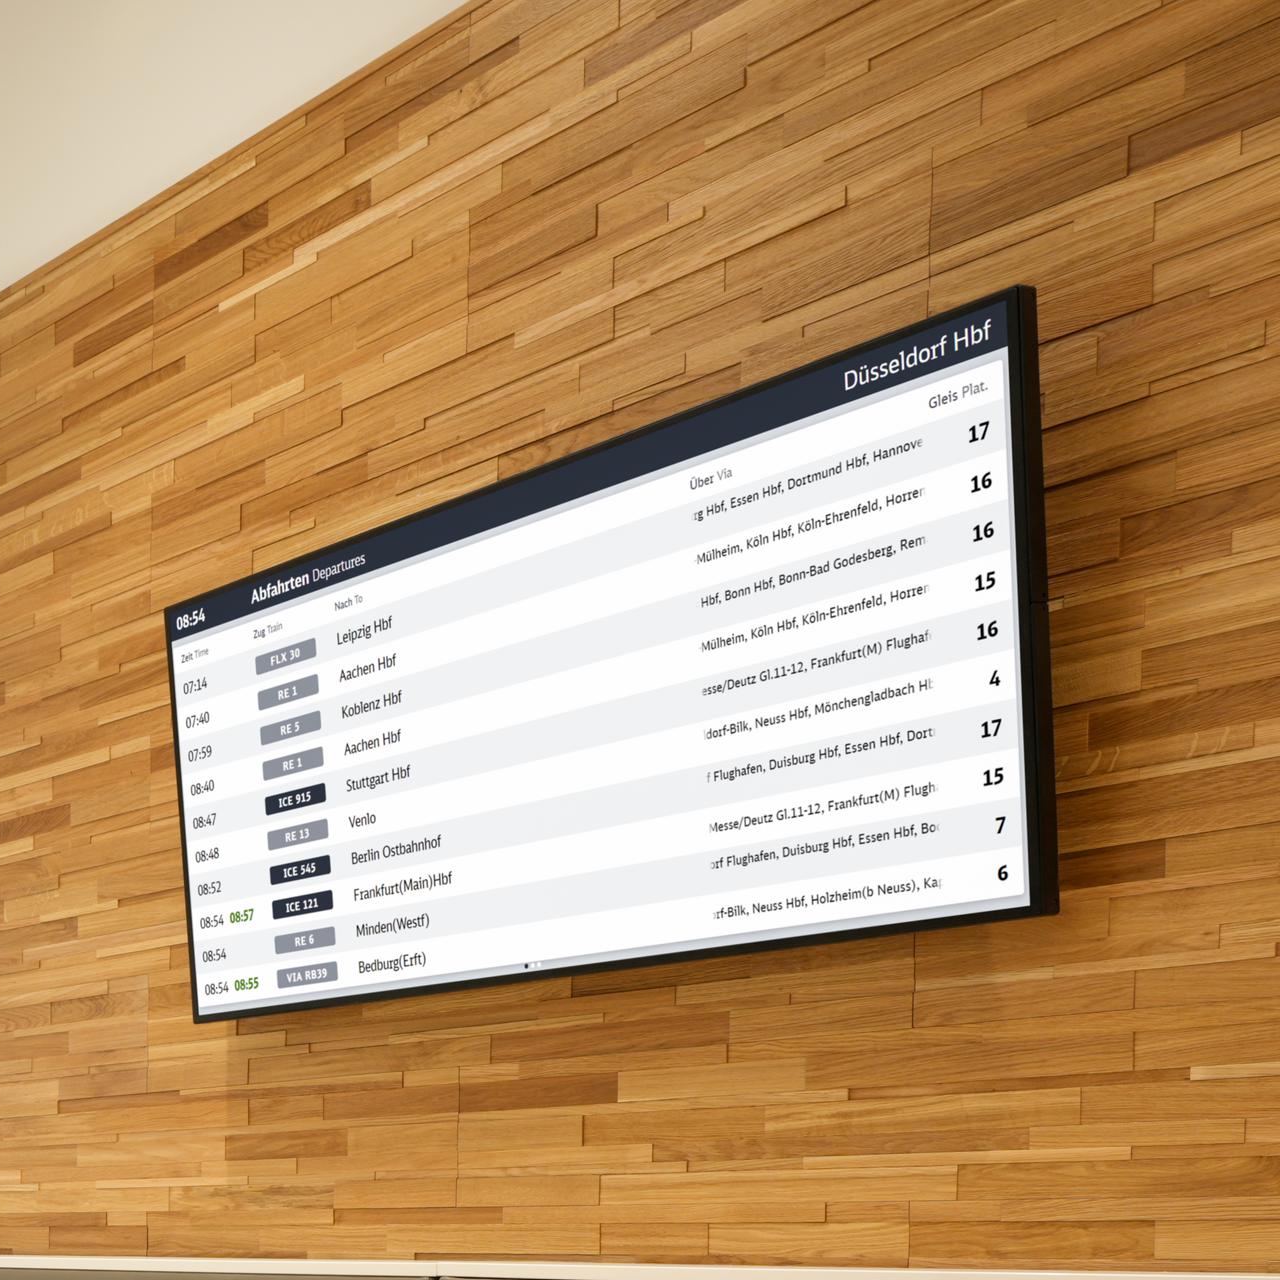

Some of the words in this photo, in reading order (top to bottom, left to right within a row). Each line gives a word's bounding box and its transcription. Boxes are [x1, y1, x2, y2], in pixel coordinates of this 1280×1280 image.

[844, 335, 946, 391] Düsseldorf
[953, 319, 992, 351] Hbf
[928, 390, 957, 409] Gleis
[961, 384, 988, 399] Plat.
[968, 421, 990, 443] 17
[690, 472, 714, 490] Über
[716, 468, 732, 481] Via
[692, 508, 704, 522] rg
[706, 499, 728, 517] Hbf,
[730, 492, 759, 510] Essen
[762, 483, 784, 499] Hbf,
[787, 462, 842, 491] Dortmund
[846, 455, 869, 472] Hbf,
[970, 472, 993, 493] 16
[746, 534, 769, 550] Köln
[772, 526, 795, 542] Hbf,
[798, 501, 882, 534] Köln-Ehrenfeld,
[972, 522, 994, 542] 16
[251, 572, 309, 603] Abfahrten
[313, 555, 365, 581] Departures
[701, 590, 722, 608] Hbf,
[725, 584, 751, 601] Bonn
[754, 577, 776, 593] Hbf,
[779, 561, 830, 586] Bonn-Bad
[833, 542, 896, 570] Godesberg,
[974, 572, 996, 592] 15
[335, 599, 352, 611] Nach
[355, 595, 363, 604] To
[176, 609, 206, 630] 08:54
[751, 624, 774, 639] Köln
[777, 617, 799, 633] Hbf,
[802, 594, 886, 626] Köln-Ehrenfeld,
[253, 629, 265, 639] Zug
[267, 622, 283, 634] Train
[337, 625, 371, 645] Leipzig
[374, 616, 393, 634] Hbf
[976, 621, 999, 641] 16
[181, 652, 193, 663] Zeit
[195, 648, 208, 658] Time
[270, 651, 287, 666] FLX
[289, 648, 300, 659] 30
[760, 662, 807, 682] Gl.11-12,
[811, 642, 882, 669] Frankfurt(M)
[885, 628, 932, 652] Flughaf
[339, 663, 375, 682] Aachen
[378, 654, 397, 671] Hbf
[989, 670, 1001, 686] 4
[183, 677, 207, 694] 07:14
[278, 688, 290, 700] RE
[292, 687, 297, 696] 1
[342, 700, 381, 719] Koblenz
[383, 691, 402, 708] Hbf
[755, 713, 786, 728] Neuss
[789, 705, 811, 721] Hbf,
[815, 682, 914, 714] Mönchengladbach
[186, 712, 210, 728] 07:40
[281, 725, 292, 735] RE
[295, 722, 300, 732] 5
[980, 719, 1003, 739] 17
[344, 737, 380, 755] Aachen
[382, 729, 401, 746] Hbf
[188, 746, 212, 761] 07:59
[714, 763, 766, 782] Flughafen,
[769, 752, 815, 771] Duisburg
[819, 744, 841, 760] Hbf,
[845, 740, 876, 755] Essen
[879, 732, 903, 747] Hbf,
[907, 727, 935, 741] Dort
[283, 760, 295, 770] RE
[297, 758, 302, 767] 1
[191, 779, 215, 796] 08:40
[346, 771, 390, 792] Stuttgart
[392, 765, 411, 782] Hbf
[982, 768, 1004, 787] 15
[279, 796, 293, 809] ICE
[295, 791, 311, 804] 915
[776, 803, 824, 821] Gl.11-12,
[828, 786, 900, 812] Frankfurt(M)
[904, 782, 938, 797] Flugh
[193, 813, 217, 829] 08:47
[349, 812, 376, 829] Venlo
[995, 817, 1006, 834] 7
[285, 830, 297, 842] RE
[300, 827, 310, 839] 13
[726, 847, 779, 867] Flughafen,
[782, 839, 829, 858] Duisburg
[833, 835, 855, 848] Hbf,
[858, 830, 889, 844] Essen
[893, 822, 917, 838] Hbf,
[195, 847, 219, 863] 08:48
[351, 846, 379, 865] Berlin
[383, 835, 442, 858] Ostbahnhof
[283, 866, 297, 879] ICE
[301, 862, 316, 874] 545
[998, 865, 1008, 881] 6
[197, 880, 222, 896] 08:52
[353, 871, 452, 902] Frankfurt(Main)Hbf
[286, 900, 300, 912] ICE
[303, 898, 318, 909] 121
[752, 899, 782, 914] Neuss
[786, 894, 808, 908] Hbf,
[811, 885, 873, 906] Holzheim(b
[877, 880, 919, 895] Neuss),
[200, 914, 224, 929] 08:54
[229, 908, 254, 923] 08:57
[356, 914, 430, 937] Minden(Westf)
[295, 936, 307, 946] RE
[309, 934, 314, 944] 6
[202, 948, 226, 962] 08:54
[358, 952, 427, 974] Bedburg(Erft)
[286, 971, 302, 983] VIA
[306, 967, 328, 980] RB39
[204, 980, 229, 995] 08:54
[234, 977, 259, 991] 08:55
